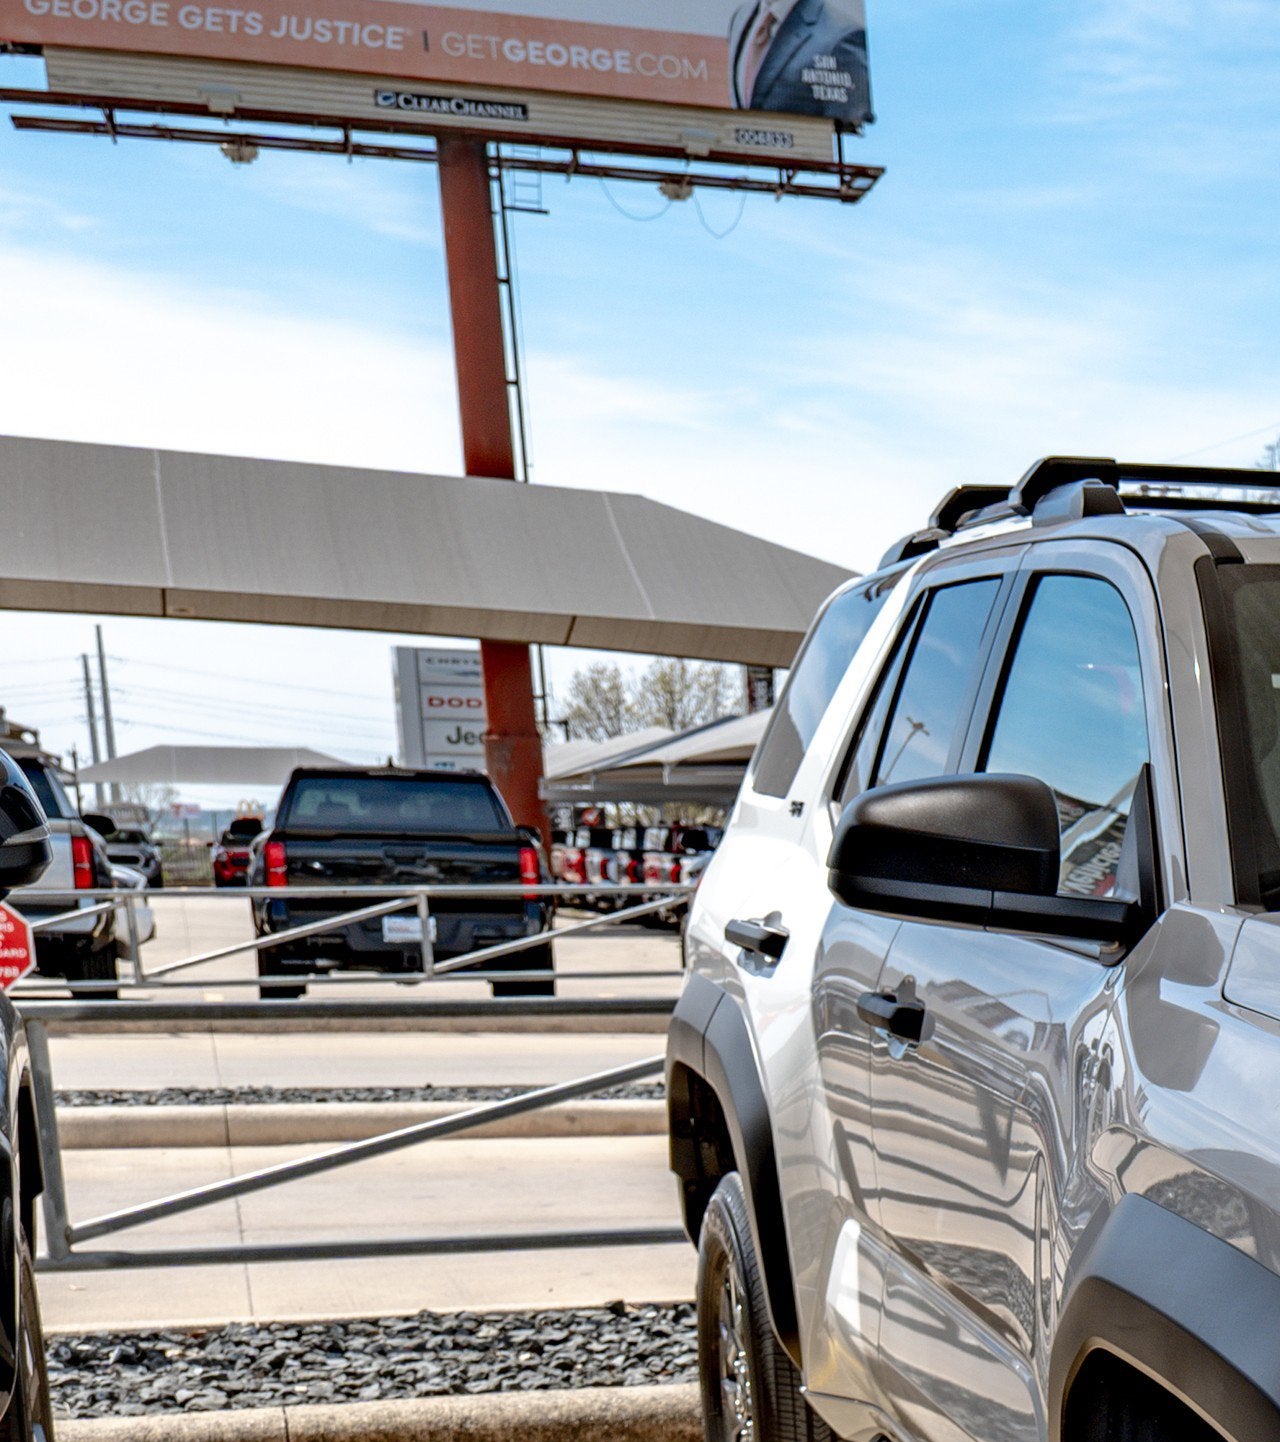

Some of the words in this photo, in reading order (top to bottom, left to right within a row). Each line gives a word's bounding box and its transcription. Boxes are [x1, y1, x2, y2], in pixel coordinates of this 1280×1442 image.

[24, 0, 169, 27] GEORGE
[178, 7, 263, 36] GETS
[812, 55, 837, 70] SAN
[811, 85, 848, 102] TEXAS
